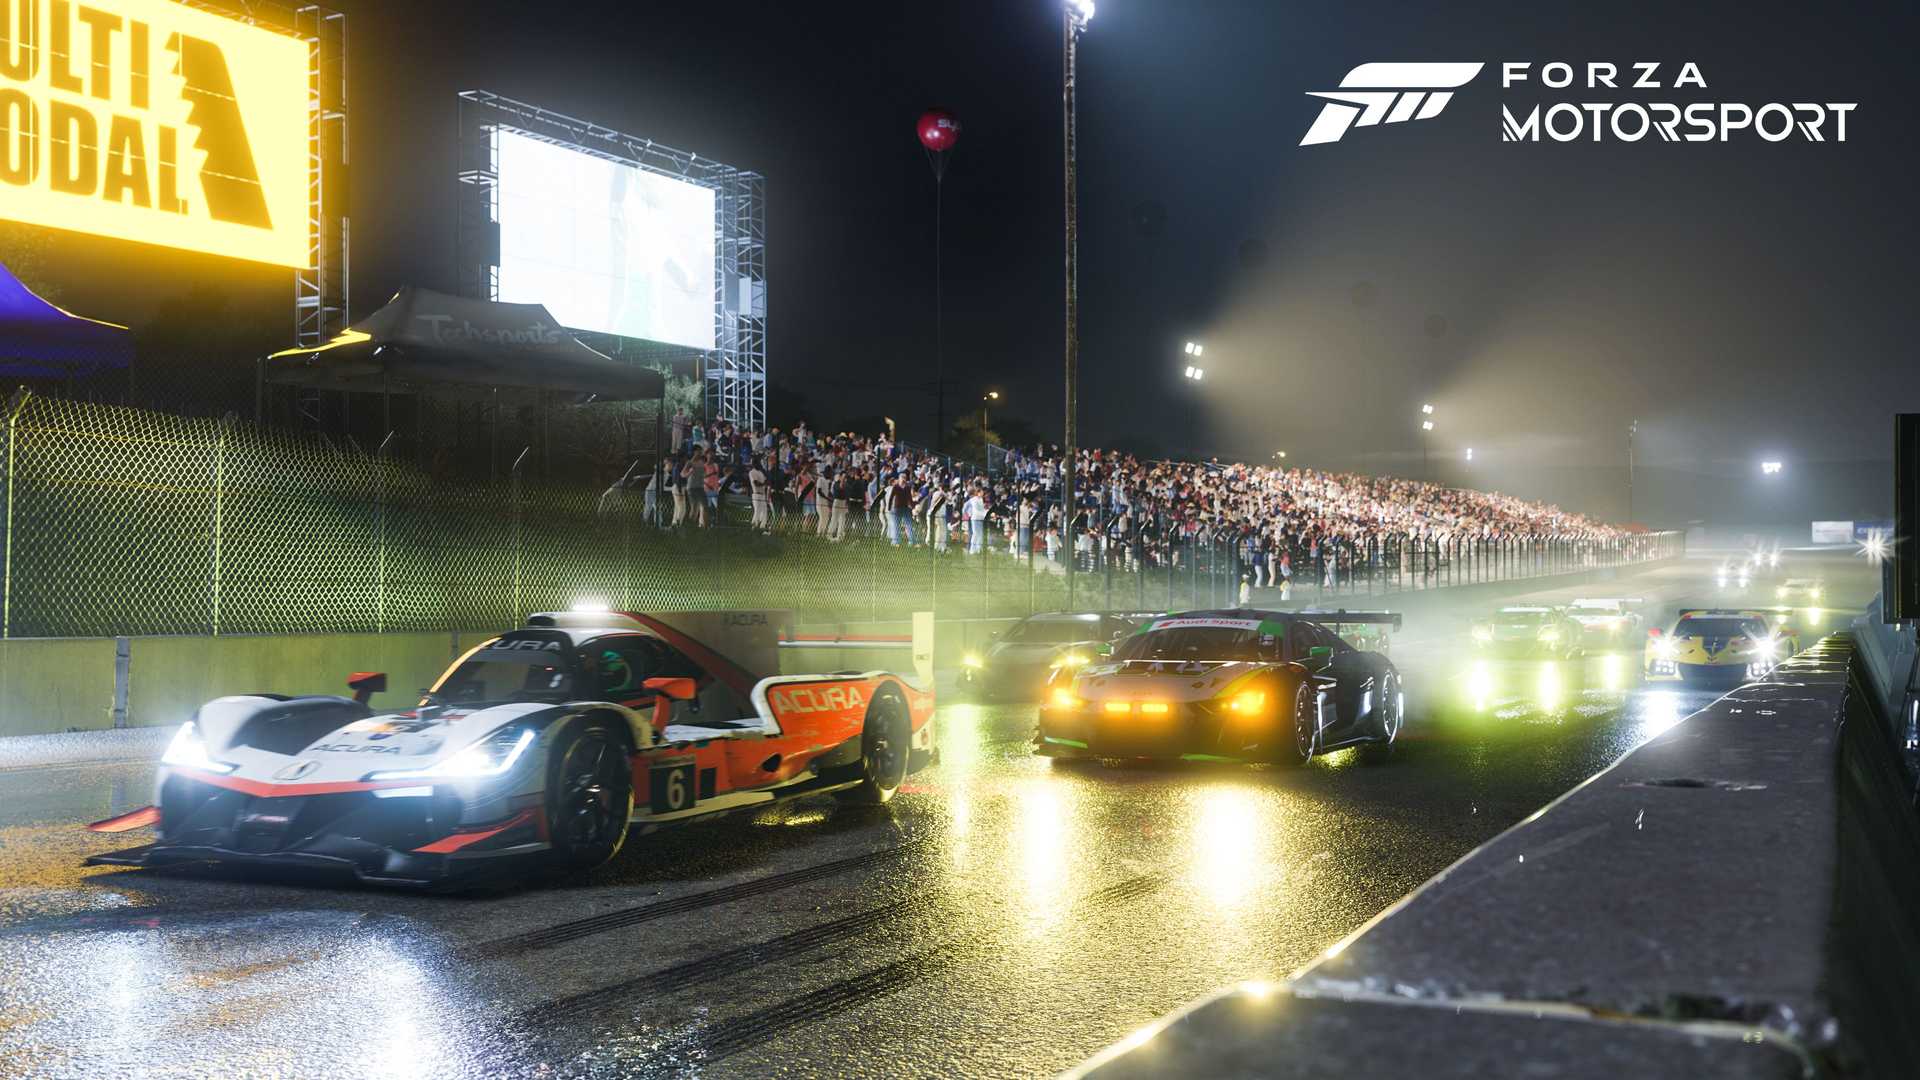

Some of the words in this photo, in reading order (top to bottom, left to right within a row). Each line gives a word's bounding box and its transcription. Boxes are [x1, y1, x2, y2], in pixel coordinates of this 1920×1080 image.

[1212, 618, 1252, 627] Sport
[492, 640, 562, 651] URA
[773, 685, 865, 715] ACURA
[309, 744, 401, 756] ACURA
[667, 768, 686, 810] 6
